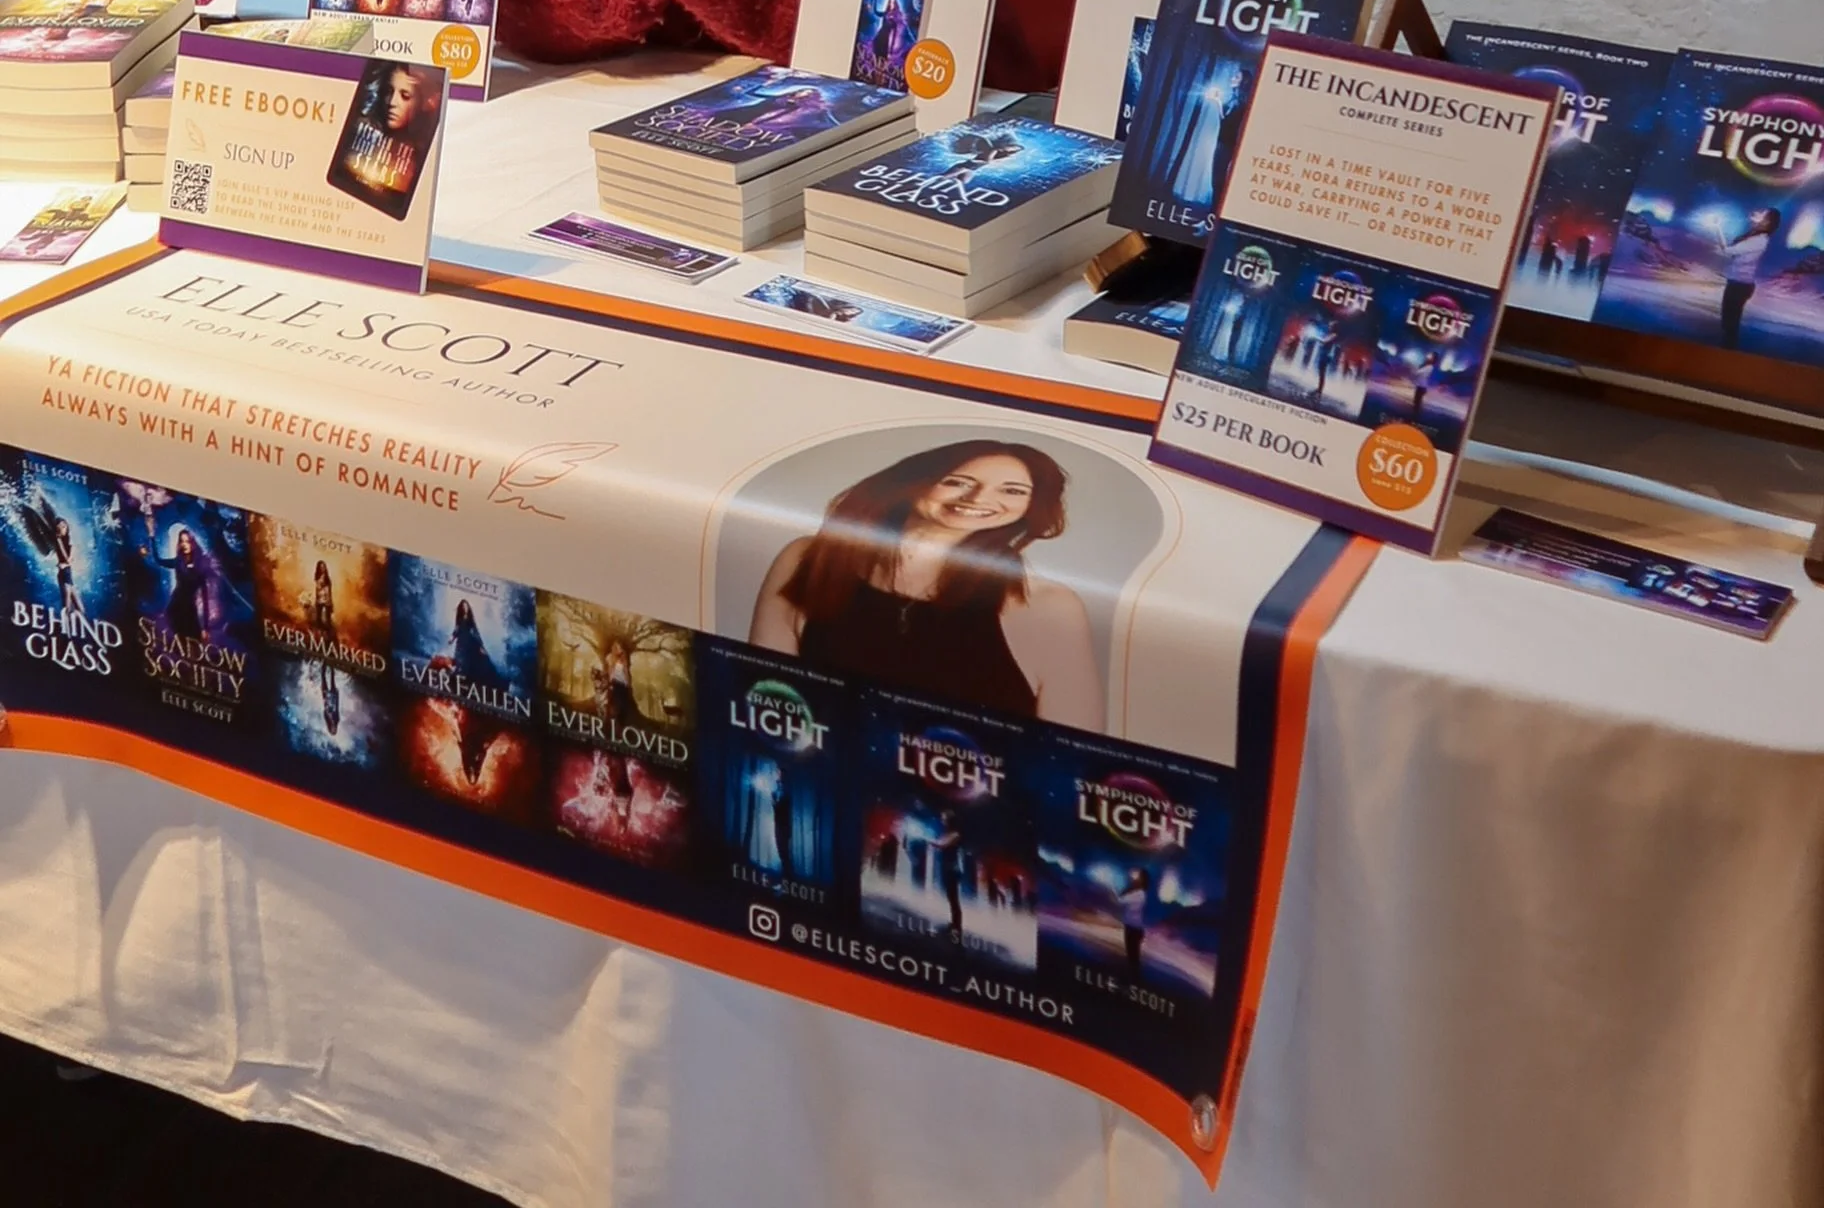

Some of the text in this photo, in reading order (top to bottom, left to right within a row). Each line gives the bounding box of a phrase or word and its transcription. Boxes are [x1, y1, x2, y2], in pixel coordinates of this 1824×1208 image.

[440, 42, 472, 60] $80
[912, 56, 946, 83] $20
[182, 80, 337, 124] FREE EBOOK!
[1275, 63, 1323, 90] THE
[1327, 74, 1535, 135] INCANDESCENT
[1581, 95, 1611, 110] OF
[1339, 106, 1443, 137] COMPLETE SERIES
[224, 142, 295, 169] SIGN UP
[1697, 125, 1822, 170] LIGH
[860, 165, 1010, 207] BEHIND
[1252, 156, 1502, 225] YEARS, NORA RETURNS TO A WORLD
[1270, 144, 1491, 205] LOST IN A TIME VAULT FOR FIVE
[854, 178, 969, 215] GLASS
[1147, 199, 1192, 226] ELLE
[1251, 172, 1494, 241] AT WAR, CARRYING A POWER THAT
[1249, 190, 1292, 209] COULD
[1297, 201, 1332, 219] SAVE
[1368, 219, 1386, 232] OR
[1392, 225, 1455, 249] DESTROY
[1460, 242, 1477, 256] IT.
[1223, 259, 1281, 287] LIGHT
[1312, 282, 1373, 313] LIGHT
[159, 276, 625, 388] ELLE SCOTT
[1115, 312, 1166, 327] ELLE
[1406, 306, 1471, 339] LIGHT
[125, 306, 555, 411] USA TODAY BESTSELLING AUTHOR
[48, 355, 482, 479] YA FICTION THAT STRETCHES REALITY
[1198, 380, 1225, 394] ADULT
[1228, 389, 1286, 413] SPECULATIVE
[1290, 408, 1328, 425] FICTION
[42, 387, 459, 511] ALWAYS WITH A HINT OF ROMANCE
[1172, 401, 1327, 467] $25 PER BOOK
[51, 466, 89, 485] SCOTT
[1368, 448, 1423, 484] $60
[281, 526, 352, 553] ELLE SCOTT
[457, 574, 499, 594] SCOTT
[11, 600, 123, 649] BEHIND
[138, 616, 247, 674] SHADOW
[25, 632, 113, 676] GLASS
[161, 691, 232, 724] ELLE SCOTT
[730, 700, 829, 750] LIGHT
[754, 694, 806, 715] RAY OF
[898, 746, 1006, 797] LIGHT
[900, 732, 1003, 768] HARBOUR OF
[1074, 777, 1198, 819] SYMPHONY OF
[1079, 793, 1193, 848] LIGHT
[732, 863, 826, 904] ELLE SCOTT
[791, 922, 1074, 1025] @ELLESCOTT_AUTHOR
[1074, 965, 1176, 1019] ELLE SCOTT
